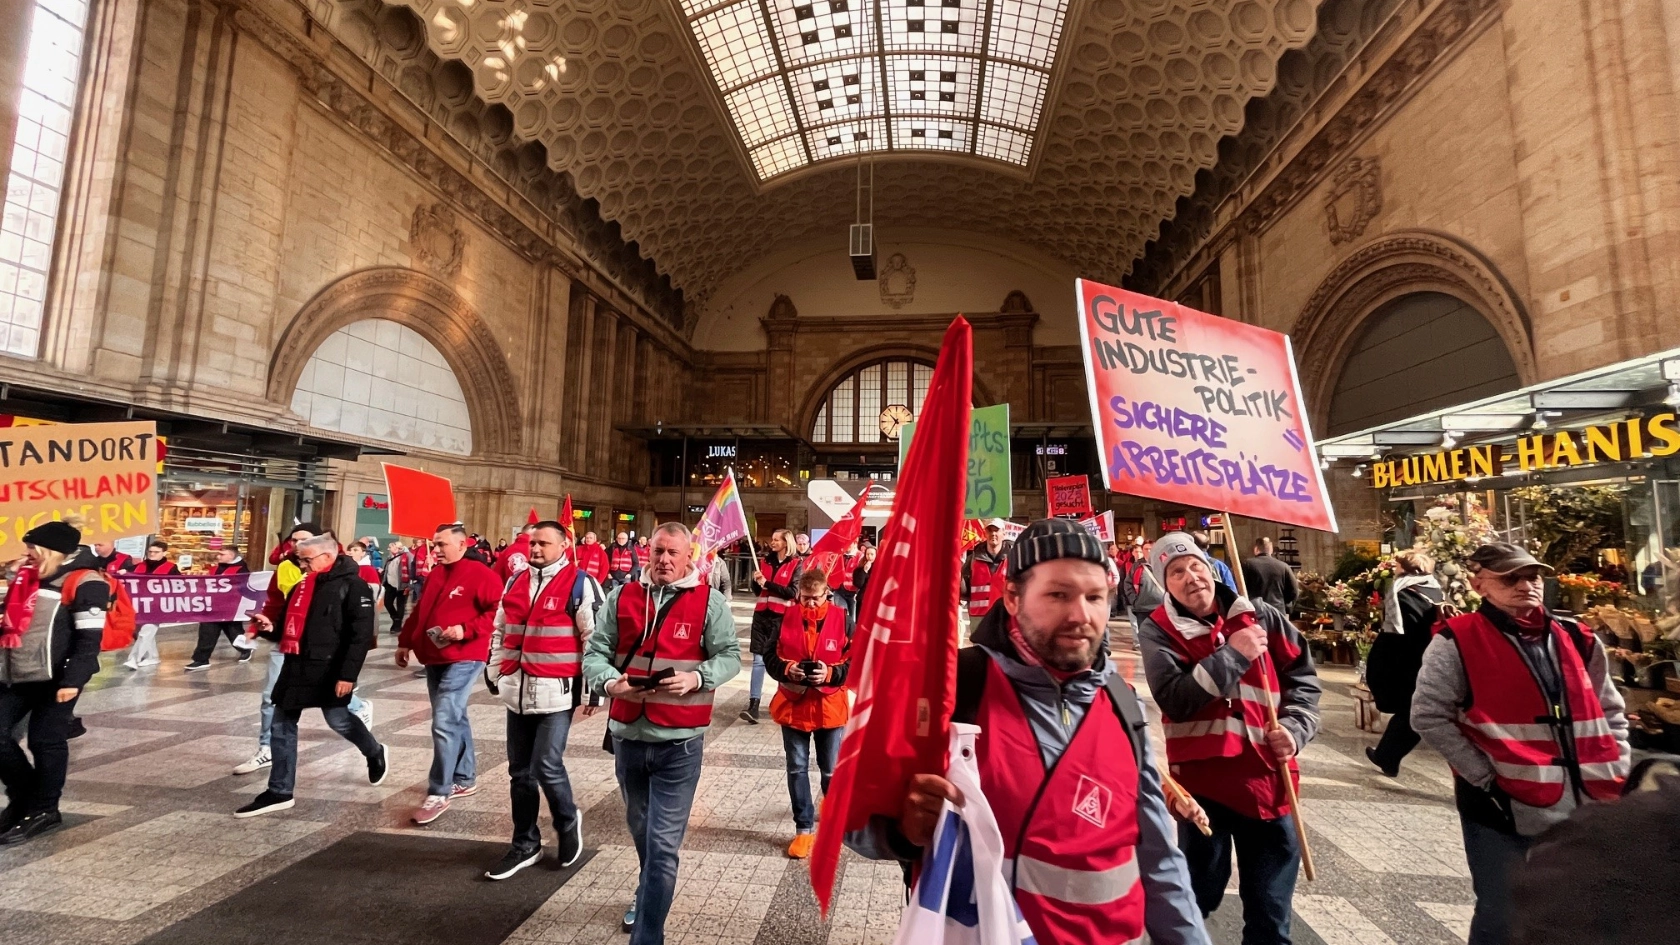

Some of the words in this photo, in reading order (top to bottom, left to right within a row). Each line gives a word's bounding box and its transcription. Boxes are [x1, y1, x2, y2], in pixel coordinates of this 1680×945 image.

[1091, 295, 1176, 343] GUTE
[1093, 337, 1257, 387] INDUSTRIE-
[1194, 386, 1293, 421] POLITIK
[1110, 396, 1228, 448] SICHERE
[709, 446, 736, 457] LUKAS
[1109, 440, 1313, 502] ARBEITSPLÄTZE
[1055, 489, 1082, 501] 2025
[1055, 498, 1084, 510] gesucht
[147, 578, 199, 594] GIBT
[206, 578, 233, 593] ES
[160, 596, 213, 613] UNS!
